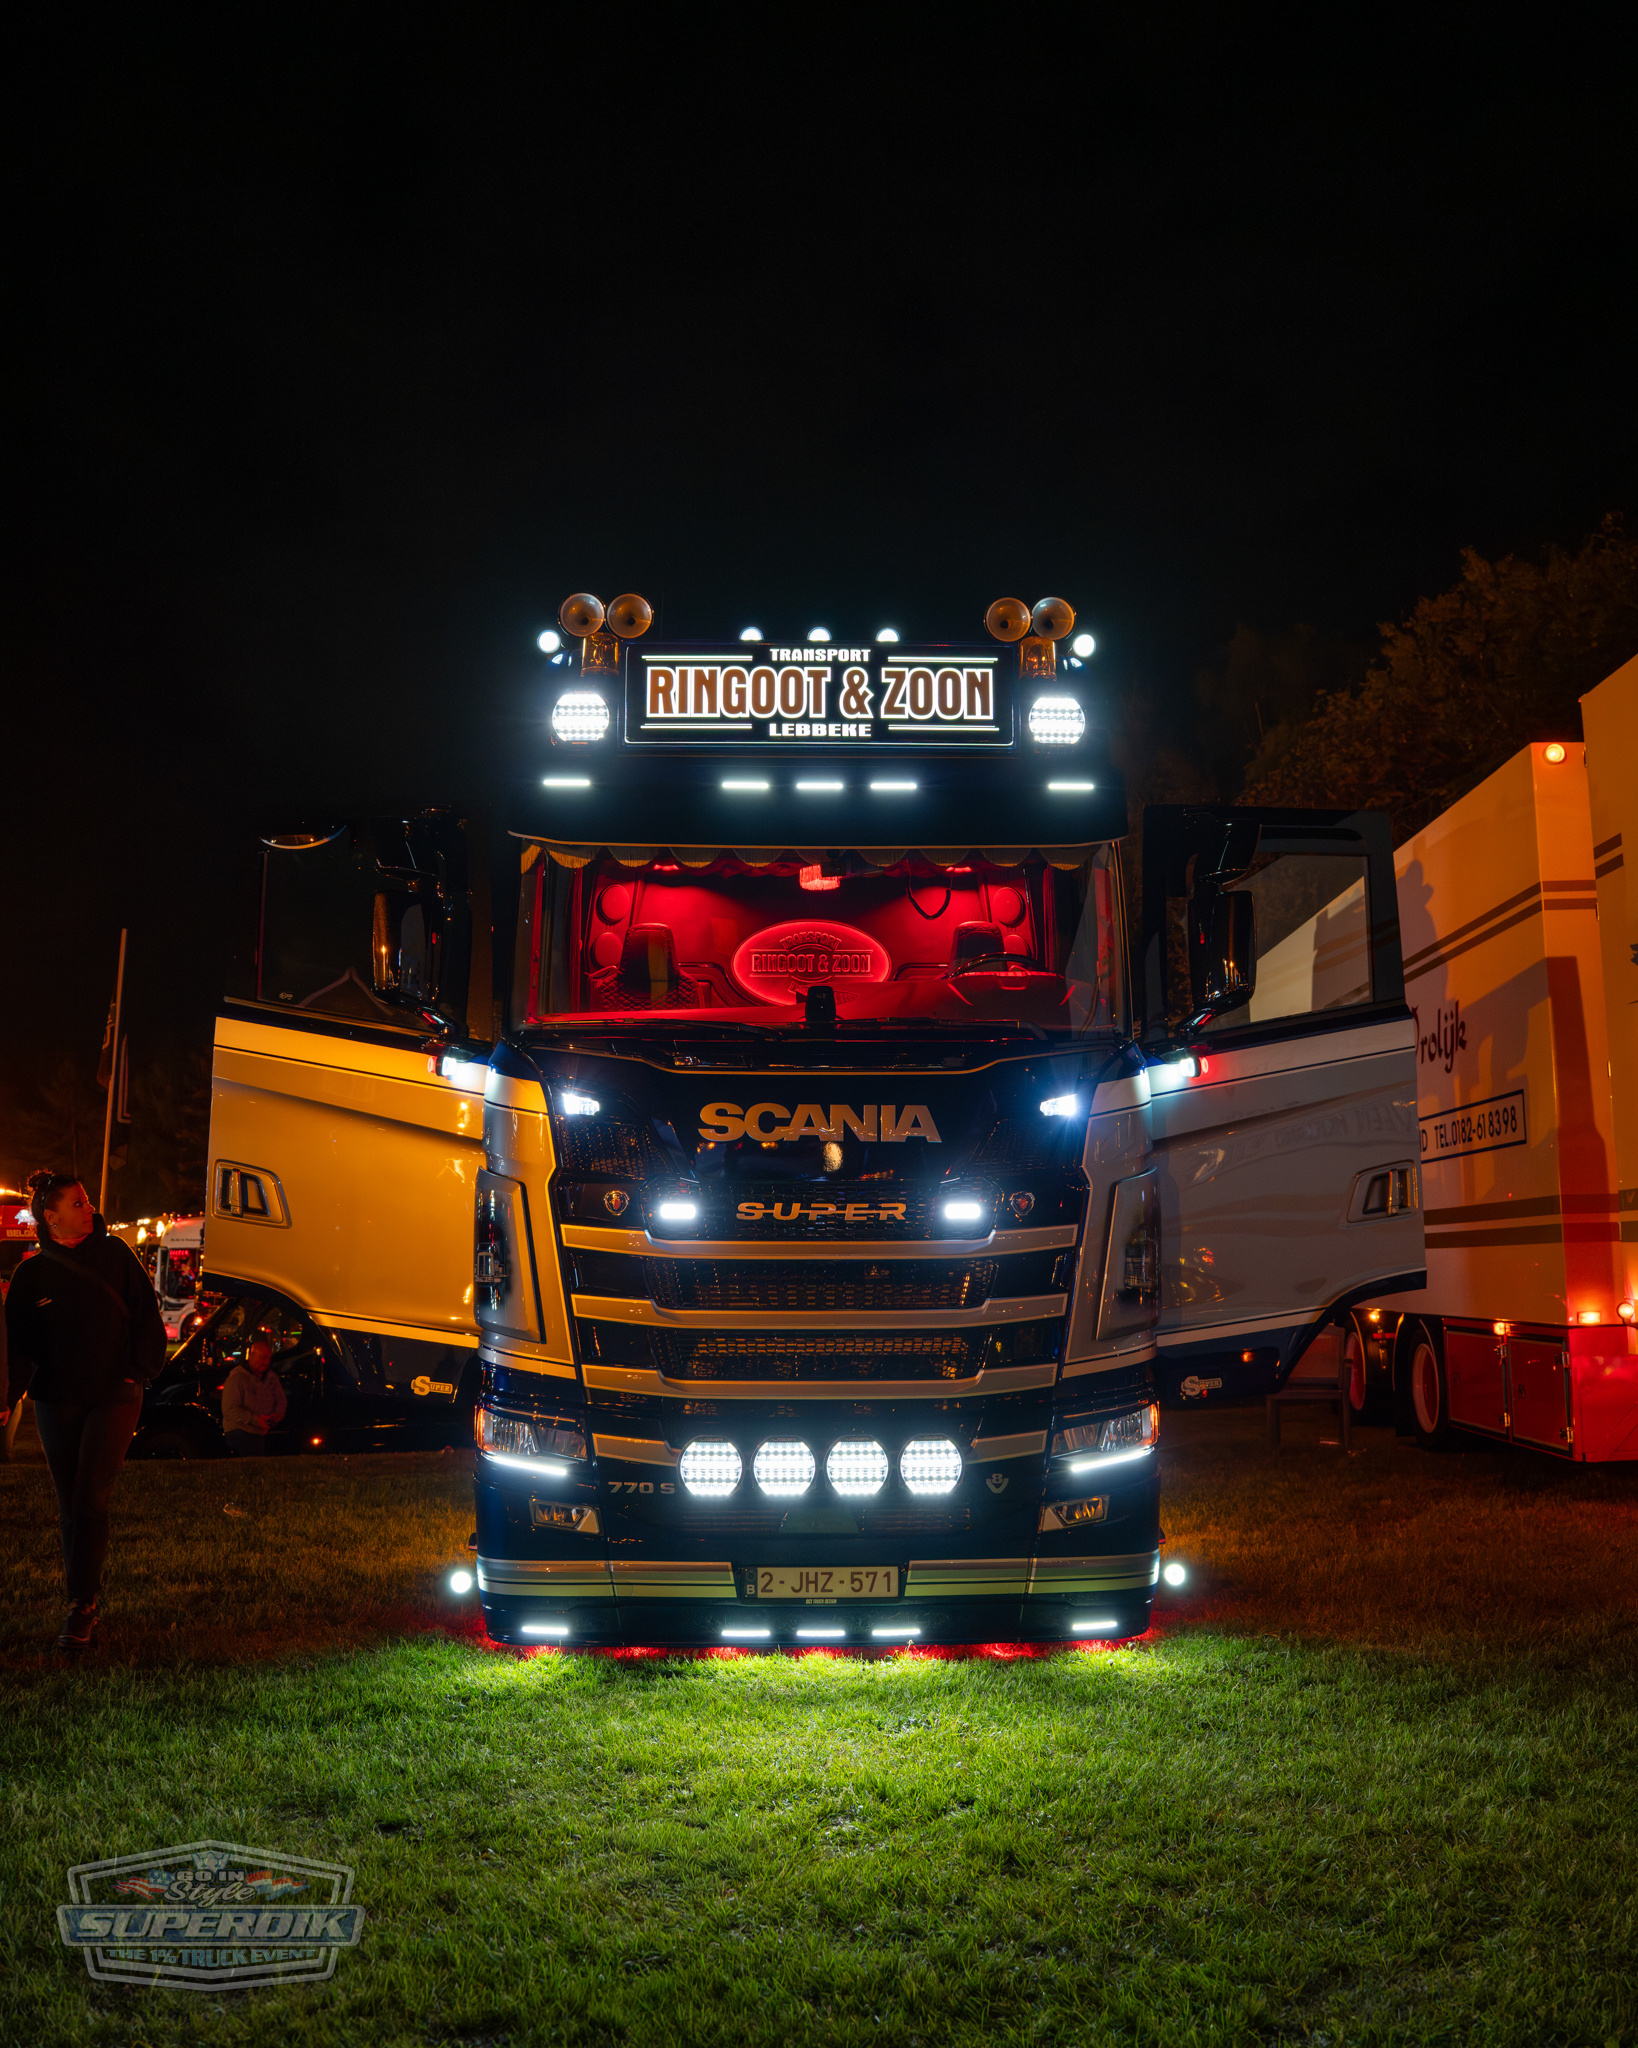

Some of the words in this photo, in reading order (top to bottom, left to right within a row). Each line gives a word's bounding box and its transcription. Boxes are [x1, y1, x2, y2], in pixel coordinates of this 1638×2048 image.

[770, 648, 871, 662] TRANSPORT
[646, 665, 831, 719] RINGOOT
[839, 666, 873, 719] &
[881, 667, 994, 720] ZOON
[769, 723, 872, 737] LEBBEKE
[779, 931, 842, 950] TRANSPORT
[751, 953, 815, 973] RINGOOT
[817, 954, 829, 973] &
[832, 954, 871, 973] ZOON
[698, 1102, 943, 1143] SCANIA
[736, 1202, 907, 1221] SUPER
[608, 1481, 654, 1494] 770
[660, 1482, 675, 1494] S
[746, 1584, 755, 1595] B
